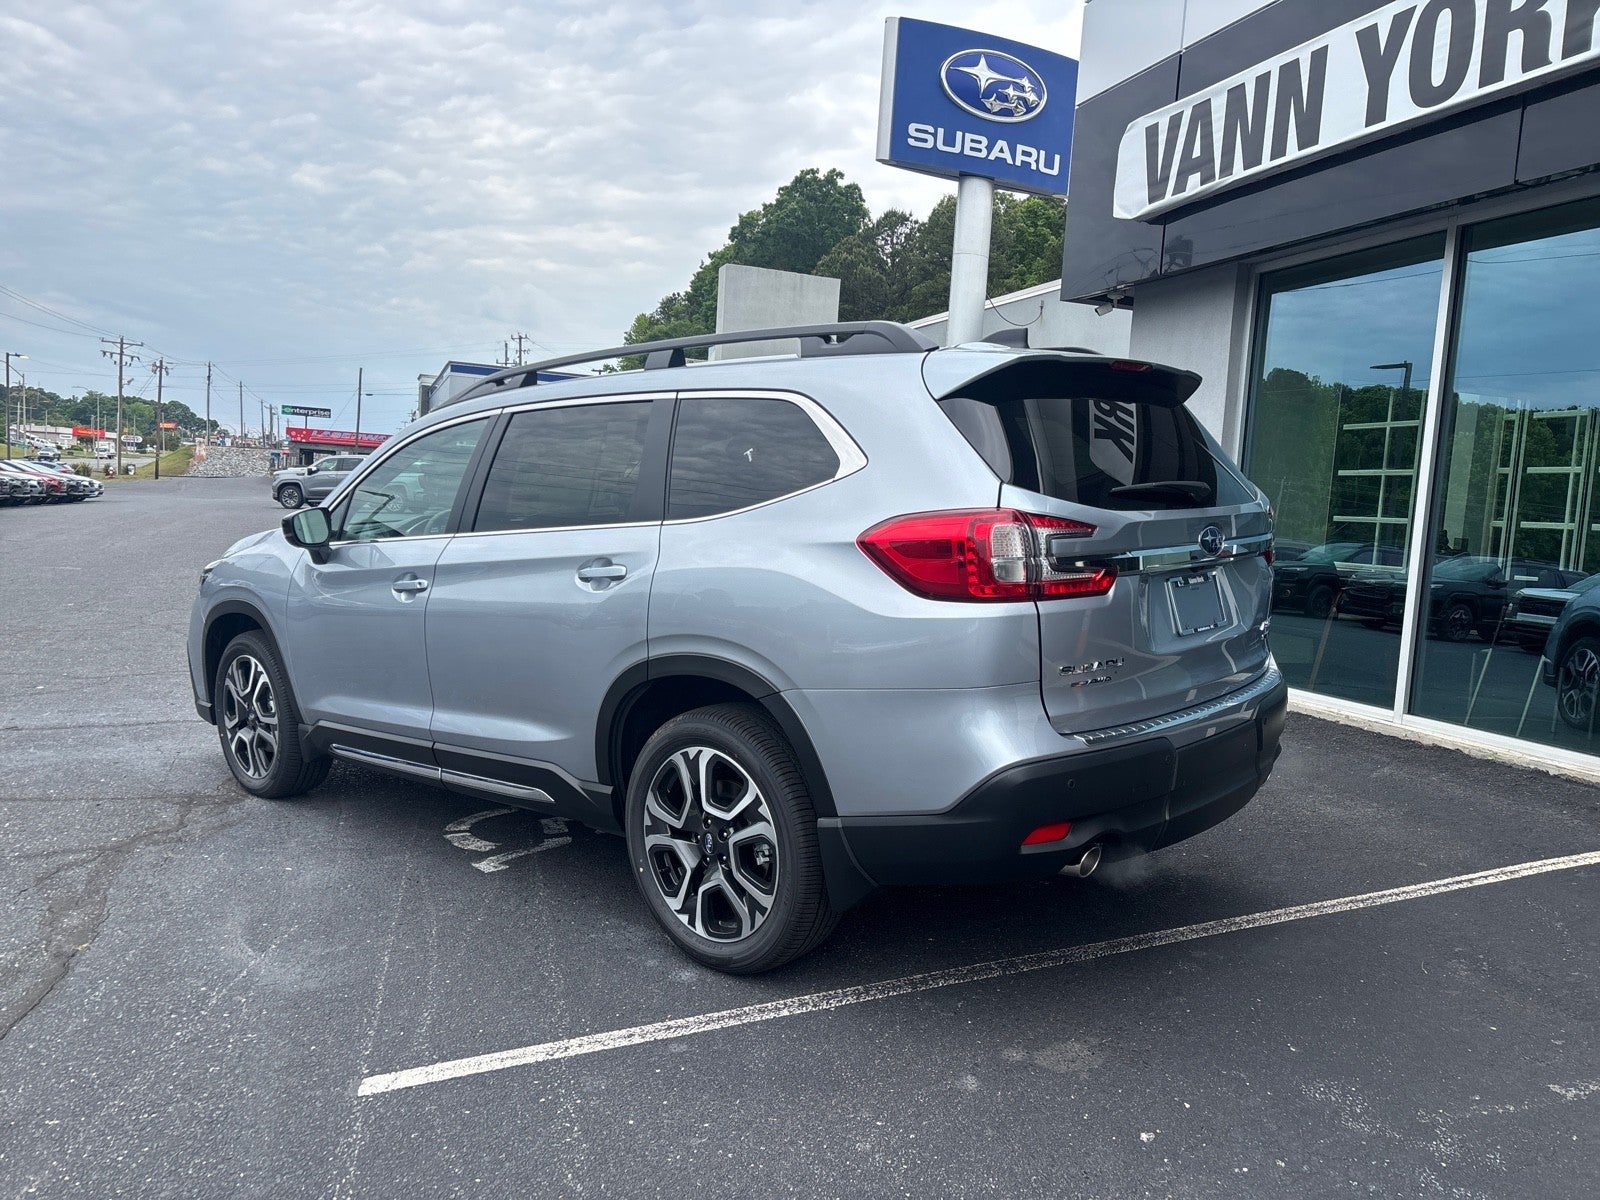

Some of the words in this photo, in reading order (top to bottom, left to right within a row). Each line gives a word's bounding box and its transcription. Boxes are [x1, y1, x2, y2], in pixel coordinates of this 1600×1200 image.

[907, 122, 1060, 177] SUBARU
[1145, 45, 1327, 204] VANN
[284, 407, 330, 416] enterprise
